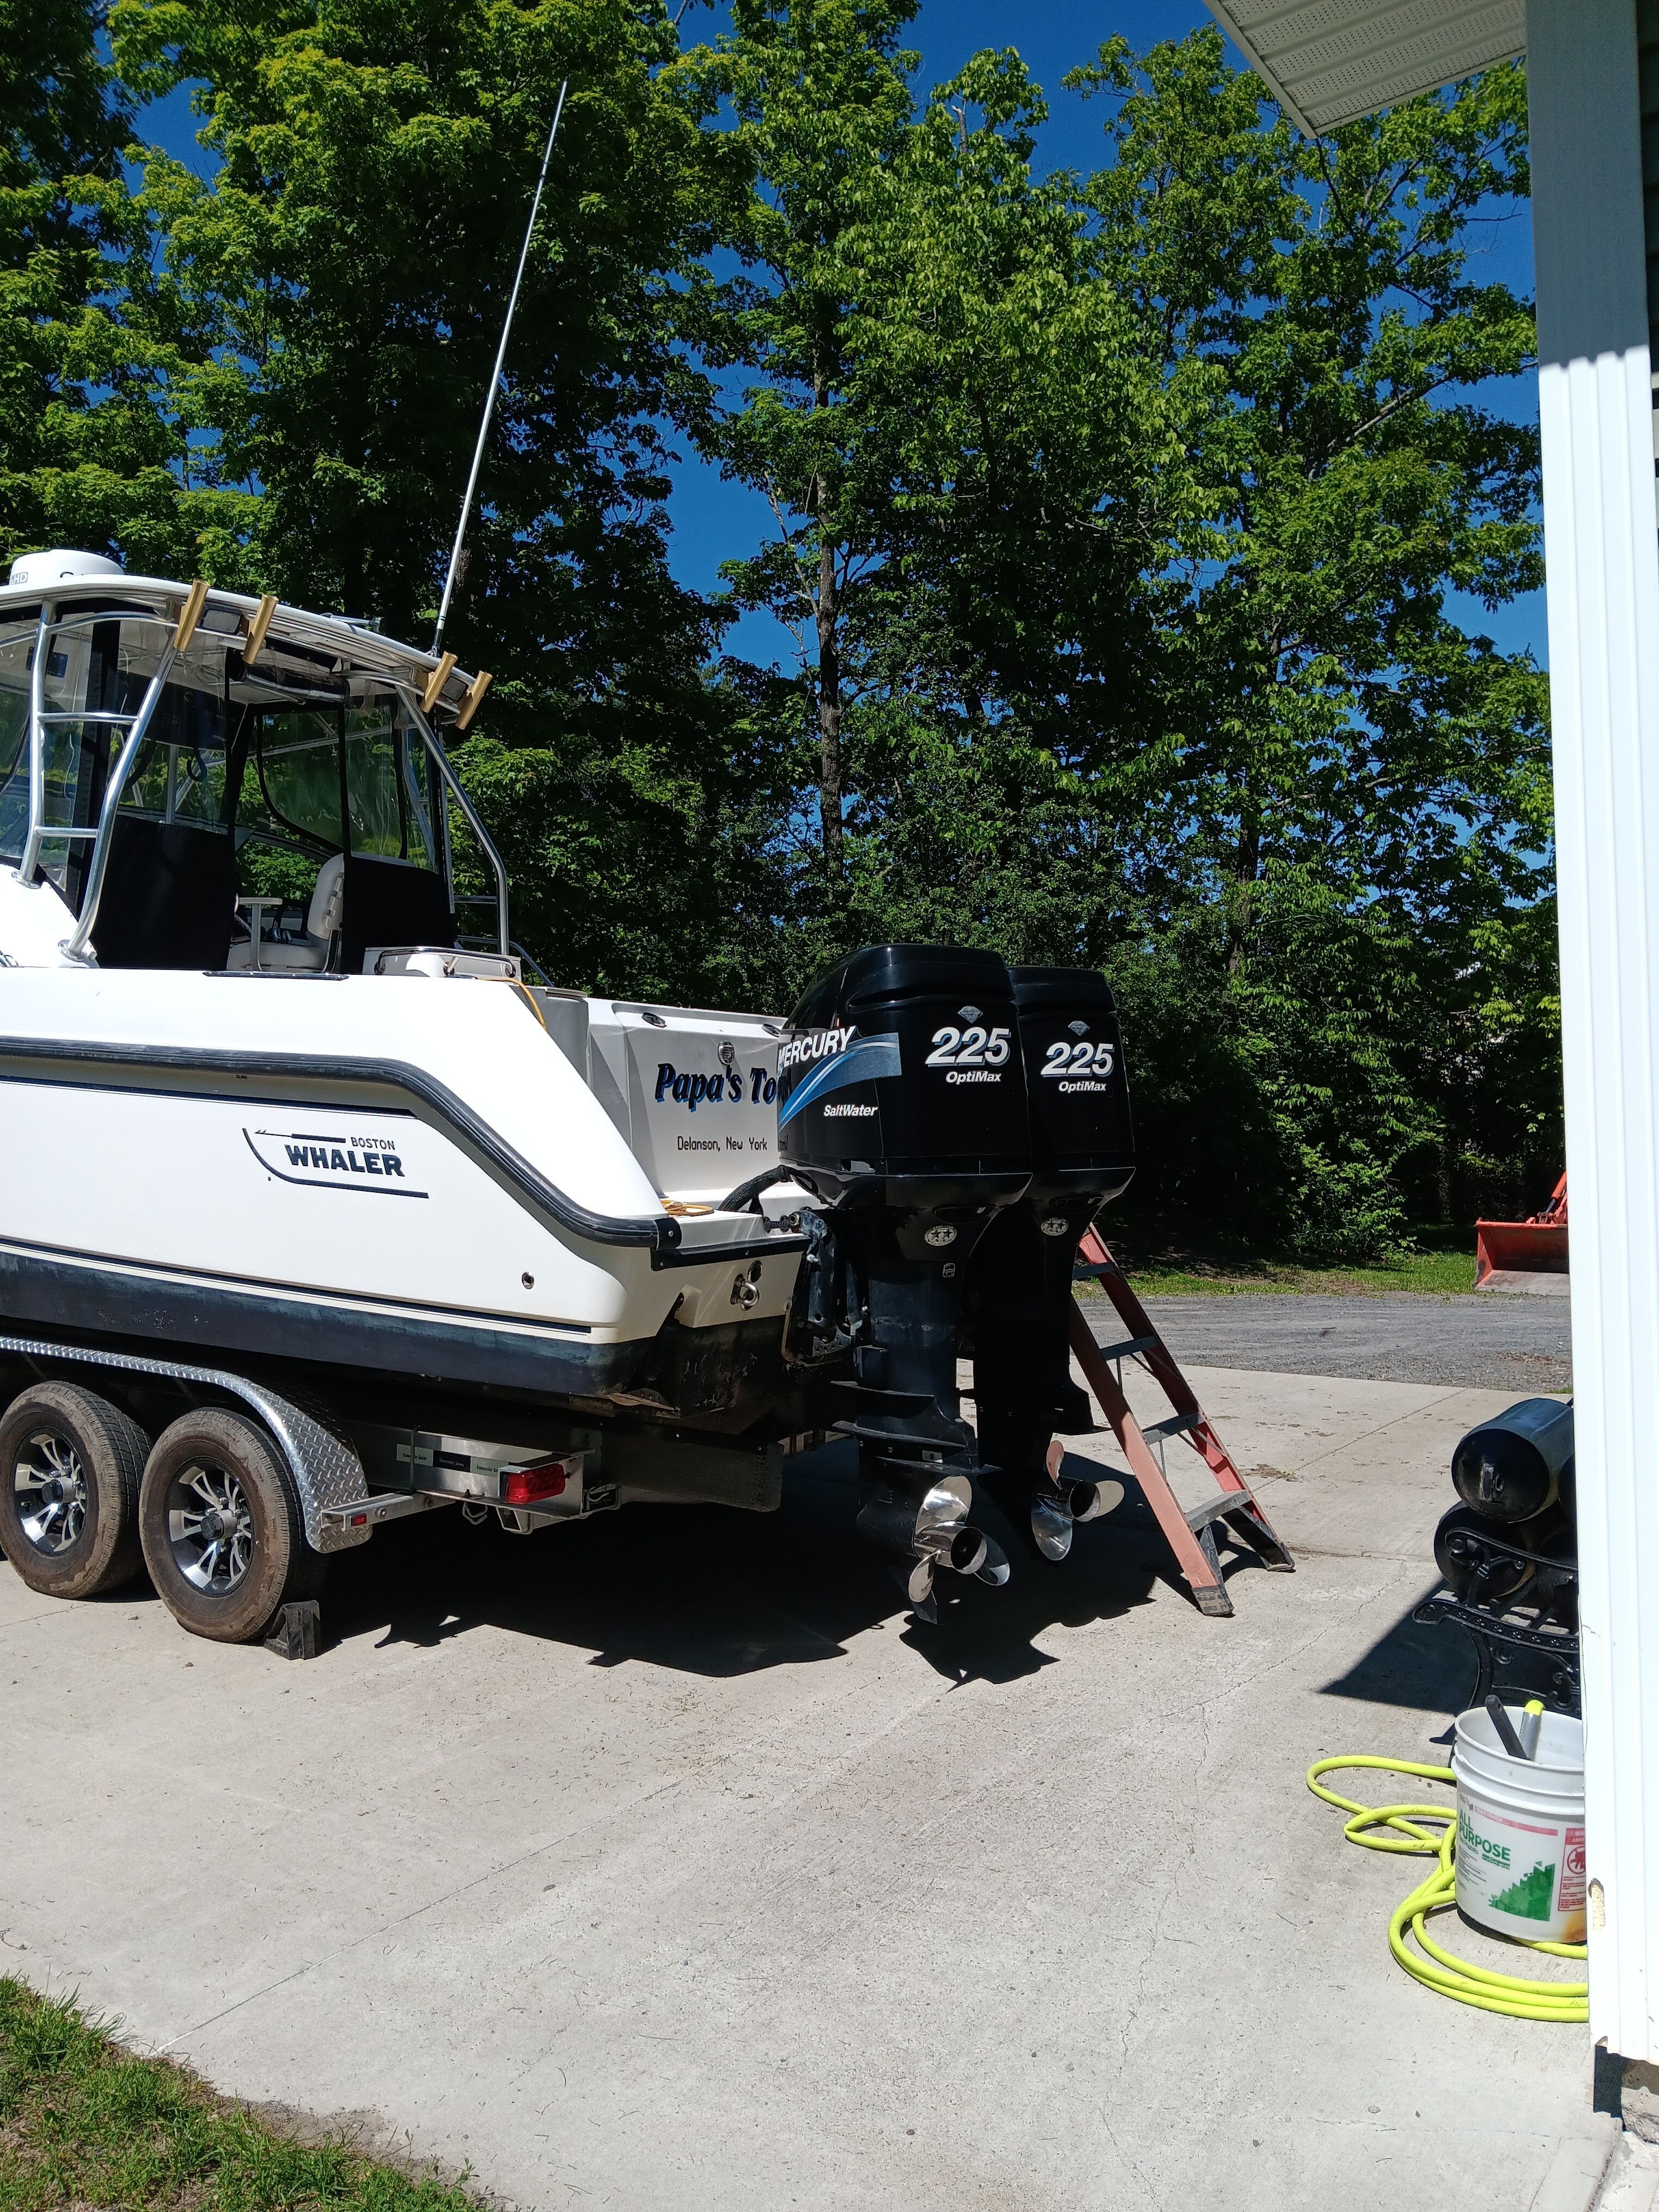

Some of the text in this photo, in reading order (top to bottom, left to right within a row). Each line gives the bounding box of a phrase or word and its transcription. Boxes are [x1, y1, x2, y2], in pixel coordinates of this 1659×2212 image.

[777, 1026, 857, 1070] MERCURY
[925, 1027, 1012, 1067] 225
[1040, 1042, 1115, 1077] 225
[655, 1063, 743, 1113] Papa's
[750, 1068, 777, 1105] To
[946, 1071, 1002, 1085] OptiMax
[1058, 1081, 1107, 1094] OptiMax
[824, 1104, 879, 1117] SaltWater
[351, 1137, 395, 1150] BOSTON
[678, 1136, 721, 1152] Delanson,
[726, 1137, 743, 1150] New
[749, 1137, 767, 1150] York
[284, 1144, 406, 1176] WHALER
[1459, 1809, 1473, 1831] ALL
[1459, 1821, 1510, 1861] PURPOSE
